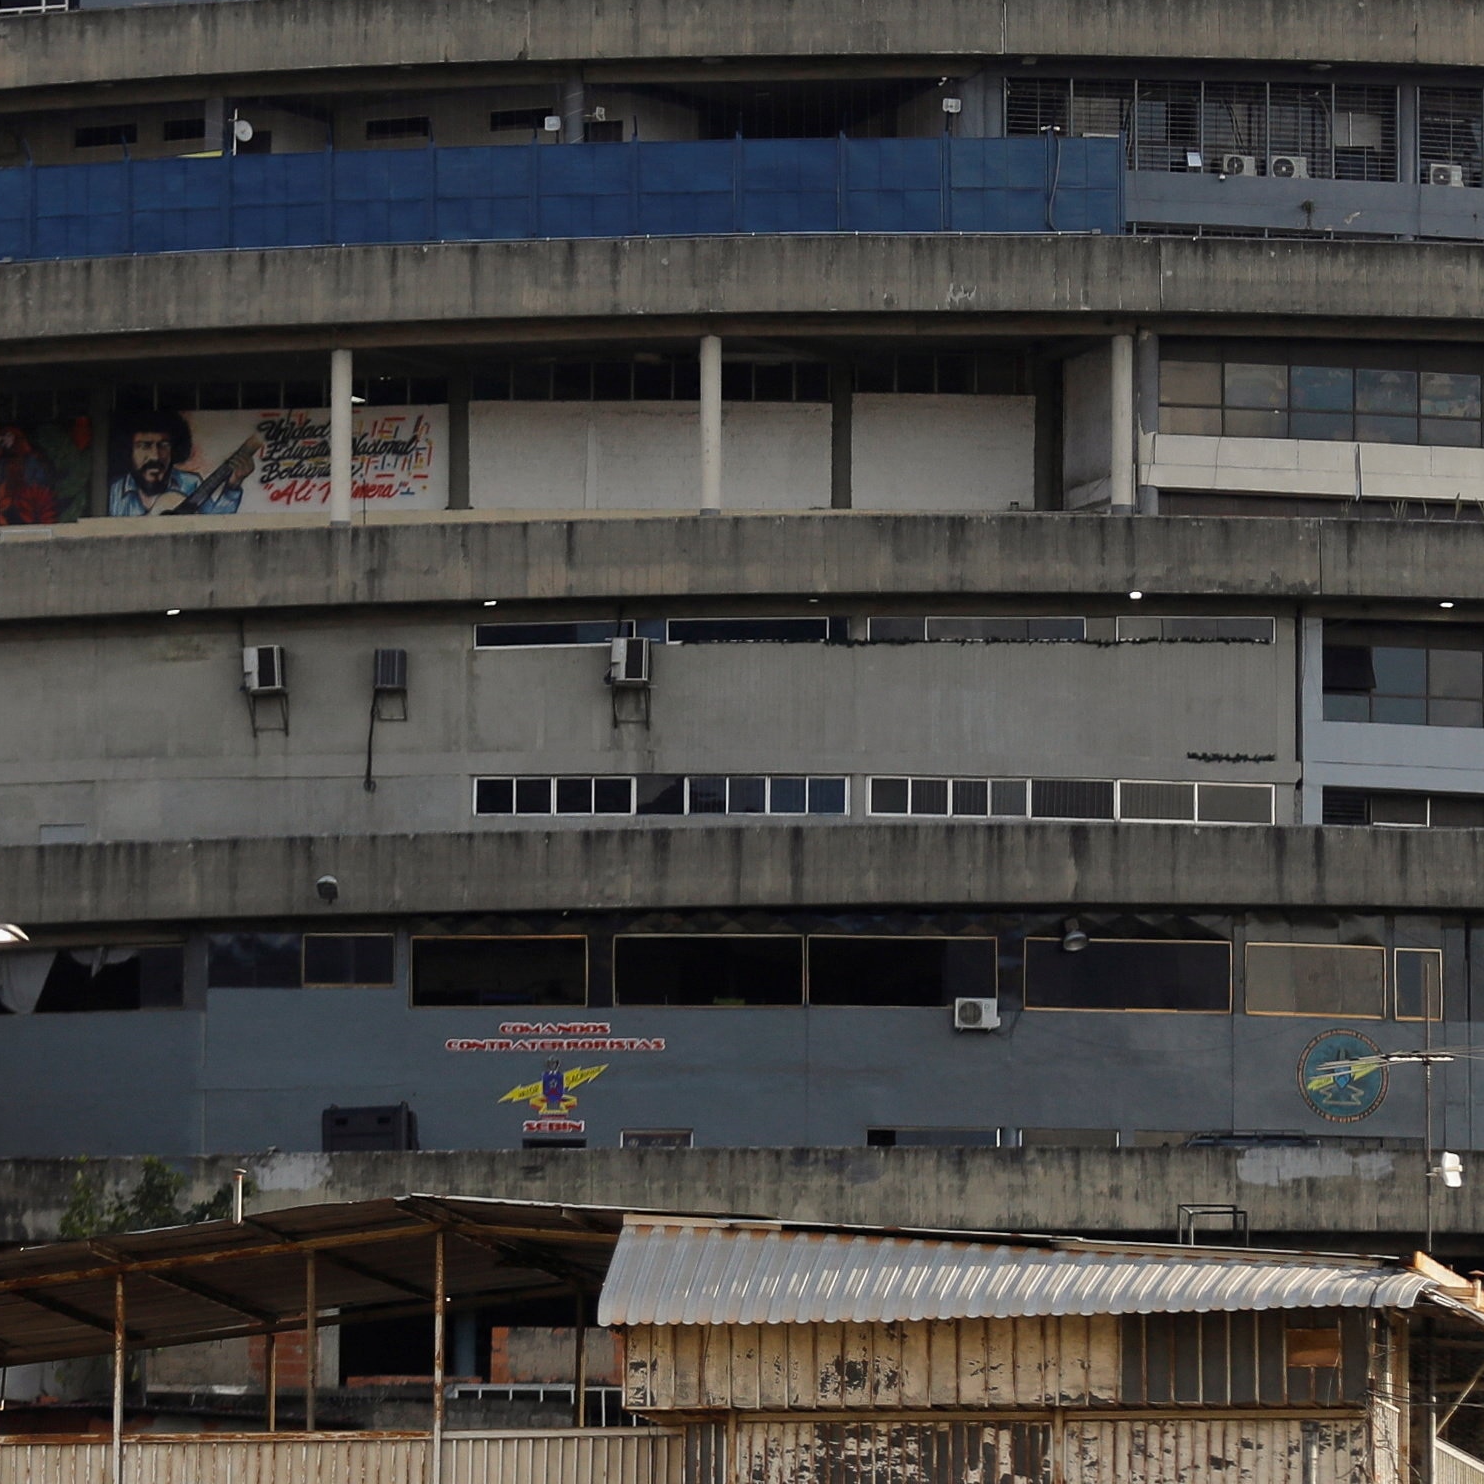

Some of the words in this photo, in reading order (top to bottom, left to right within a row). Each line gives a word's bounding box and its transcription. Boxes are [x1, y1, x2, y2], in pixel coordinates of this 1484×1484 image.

[258, 419, 332, 441] Unidad
[499, 1022, 610, 1035] COMANDOS
[445, 1037, 665, 1052] CONTRATERRORISTAS
[523, 1120, 585, 1133] SEBIN
